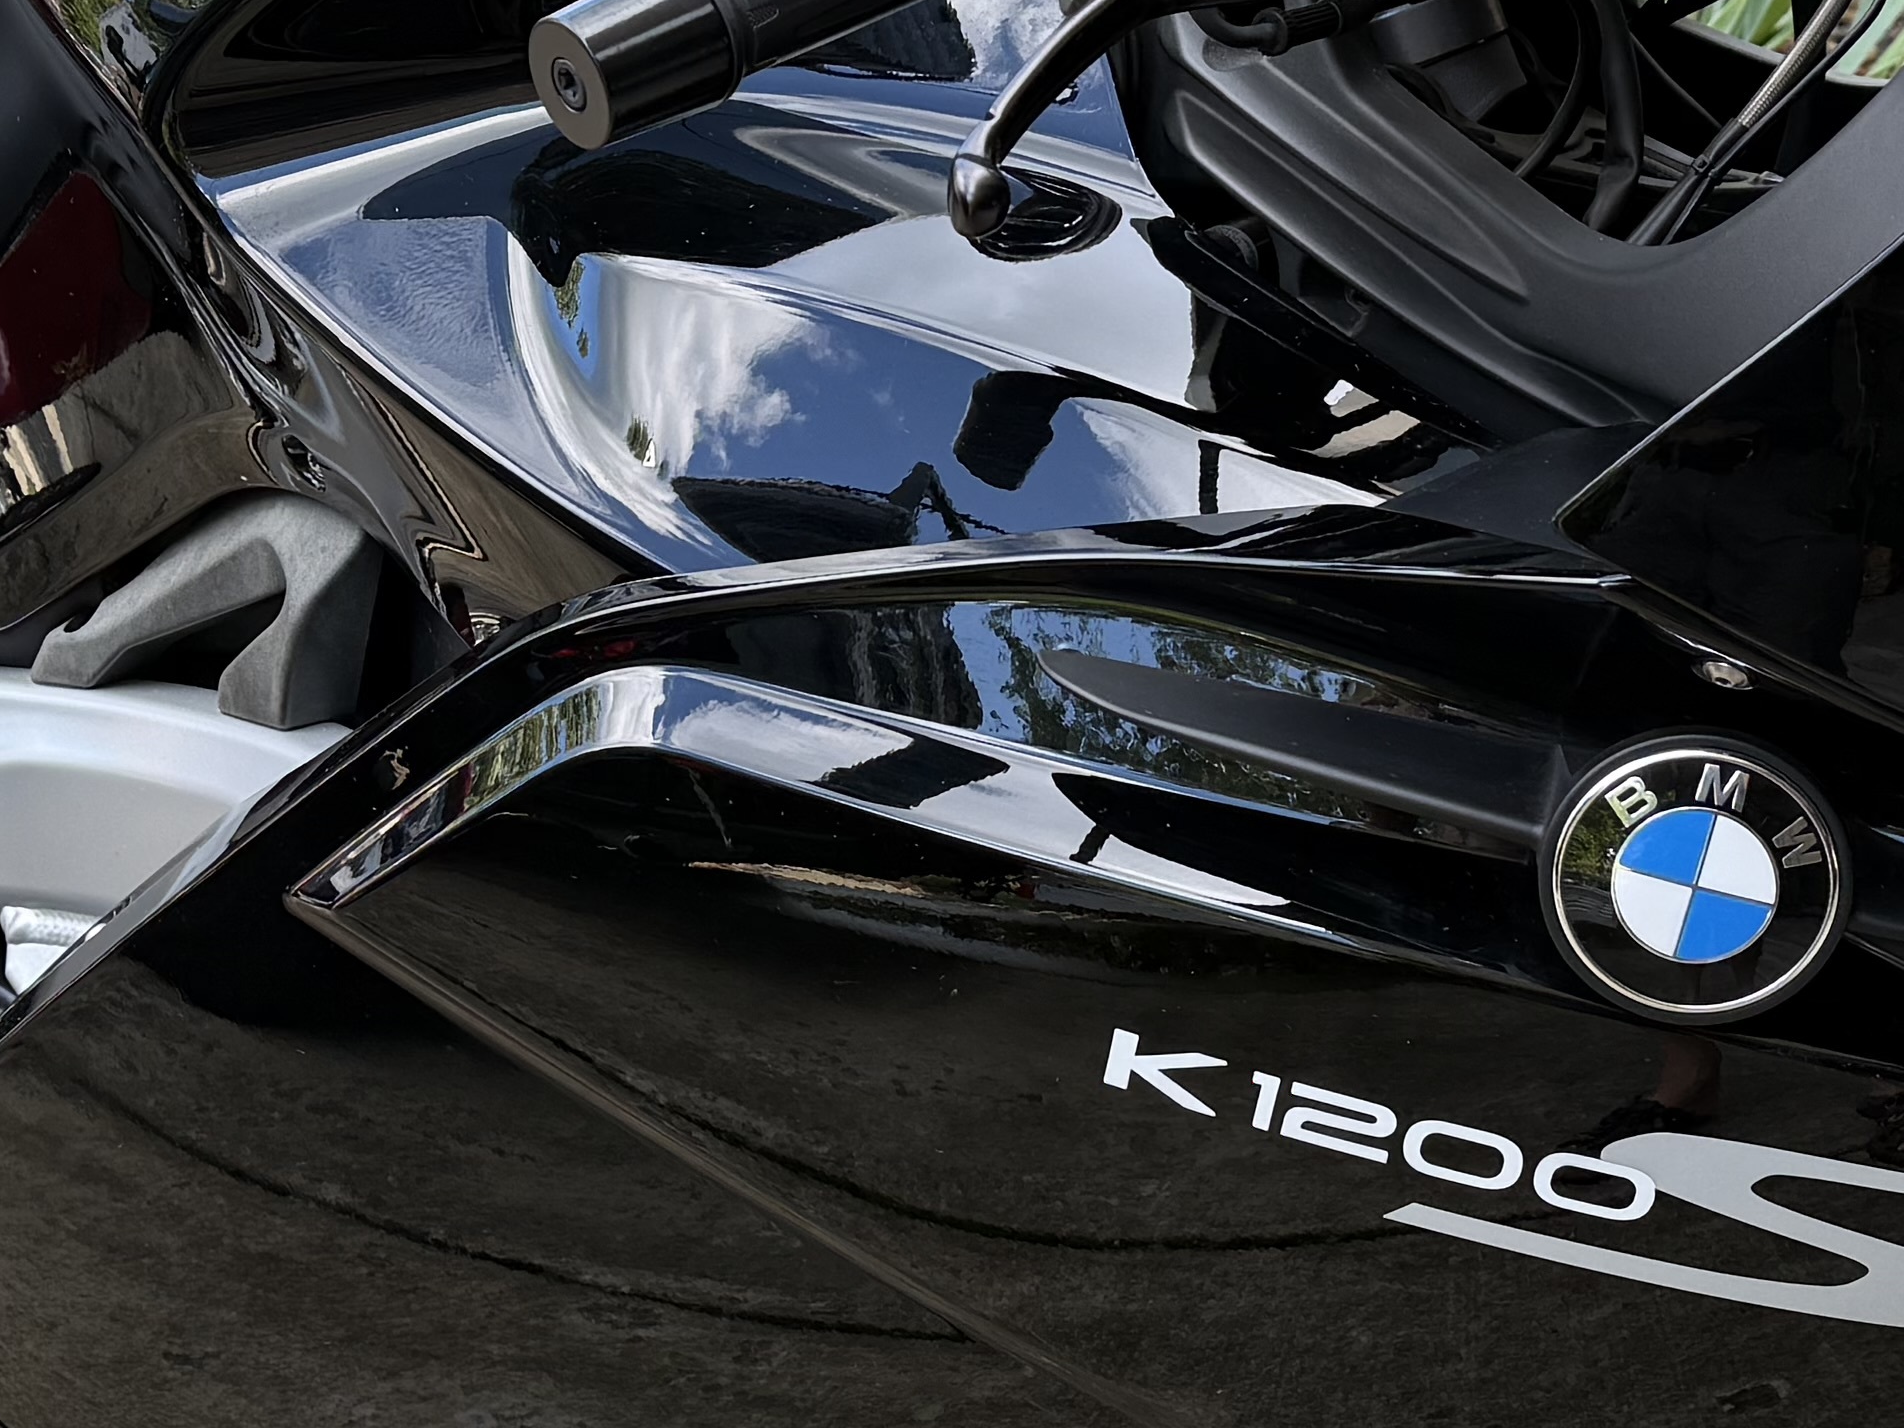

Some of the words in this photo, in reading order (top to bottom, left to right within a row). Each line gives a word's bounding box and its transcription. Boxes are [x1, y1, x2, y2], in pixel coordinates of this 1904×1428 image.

[1603, 762, 1823, 870] BMW
[1103, 1027, 1229, 1118] K
[1251, 1069, 1659, 1222] 1200
